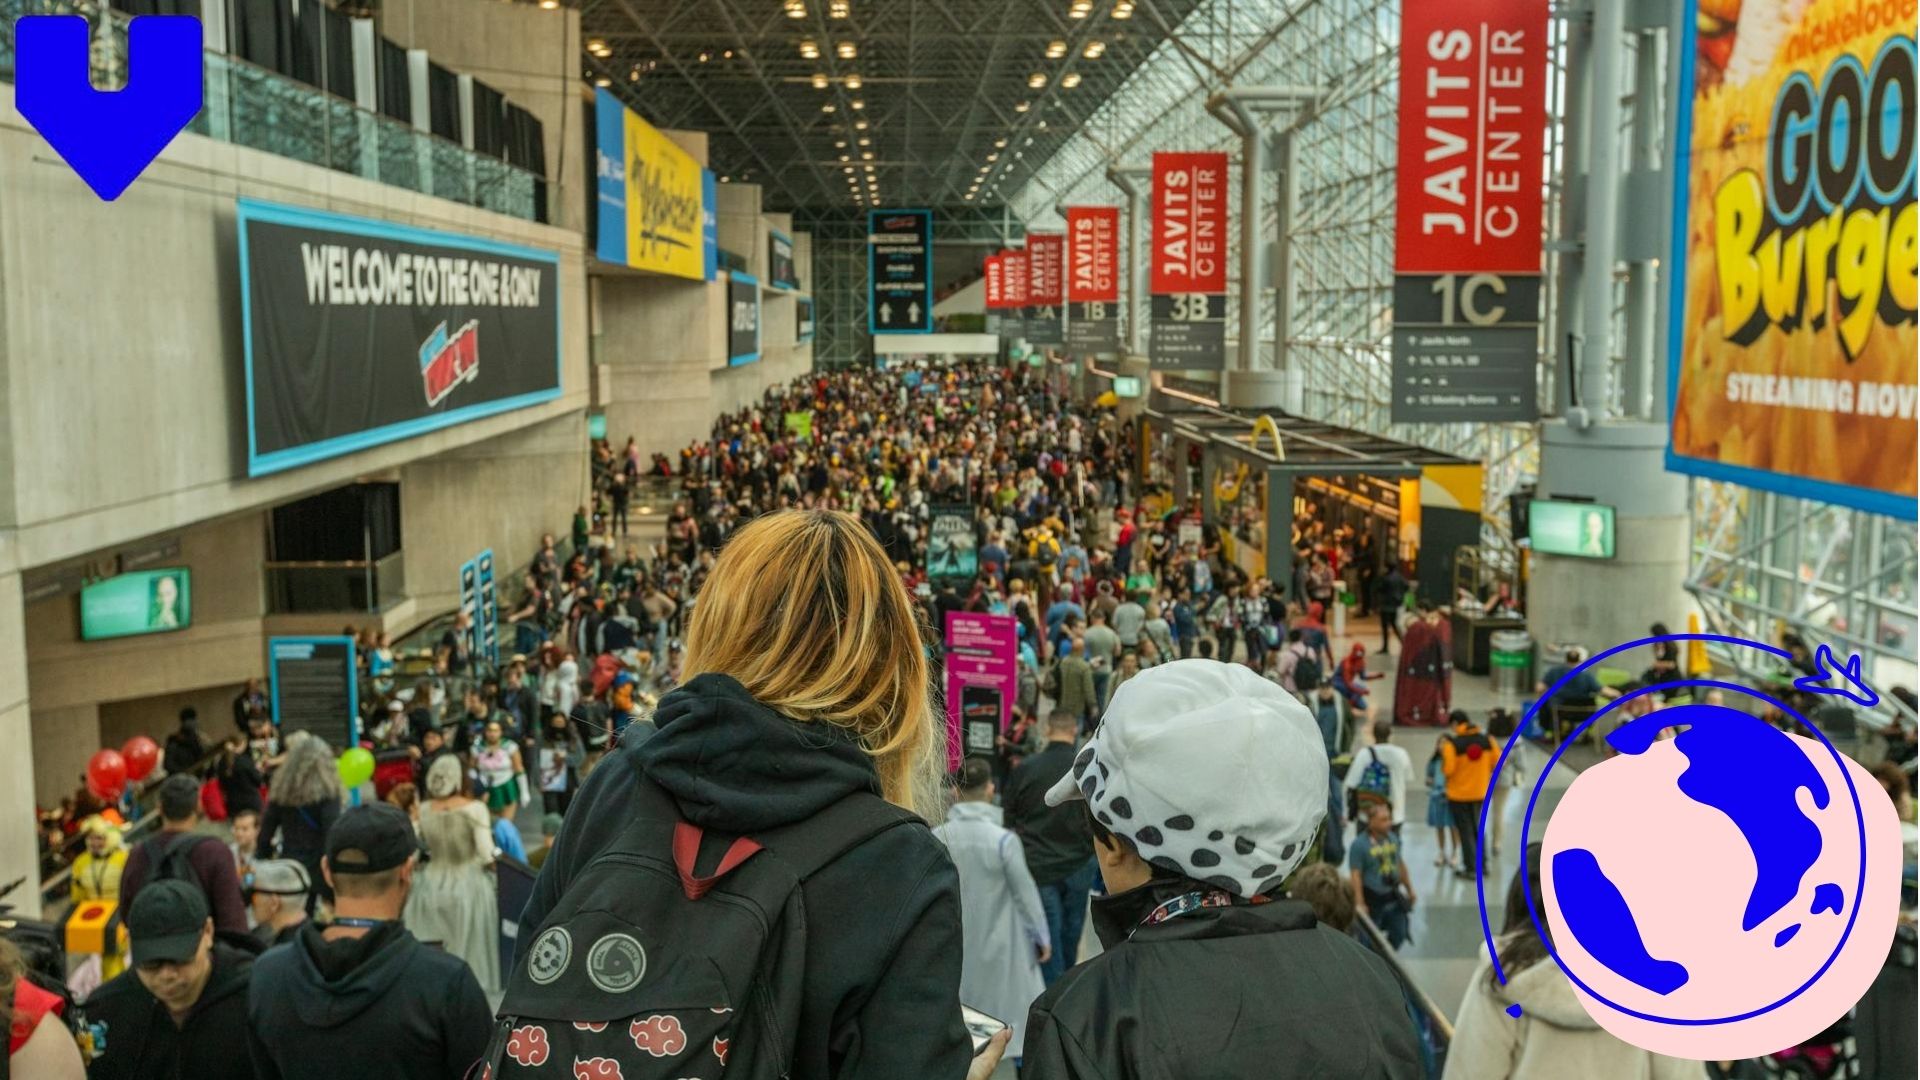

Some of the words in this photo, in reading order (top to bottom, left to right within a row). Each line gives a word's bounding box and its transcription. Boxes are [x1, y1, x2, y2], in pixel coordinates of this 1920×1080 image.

[1422, 29, 1472, 235] JAVITS
[1484, 29, 1525, 238] CENTER
[1768, 36, 1918, 224] GOO
[1076, 218, 1093, 290] JAVITS
[1097, 217, 1111, 291] CENTER
[1163, 170, 1189, 276] JAVITS
[1195, 169, 1217, 277] CENTER
[301, 242, 413, 306] WELCOME
[412, 254, 438, 306] TO
[437, 257, 469, 306] THE
[469, 260, 499, 306] ONE
[500, 264, 510, 307] &
[509, 265, 541, 308] ONLY
[1004, 256, 1016, 300] JAVITS
[1031, 242, 1045, 296] JAVITS
[1432, 273, 1507, 326] 1C
[1082, 302, 1106, 320] 1B
[1169, 293, 1210, 321] 3B
[1726, 372, 1855, 414] STREAMING
